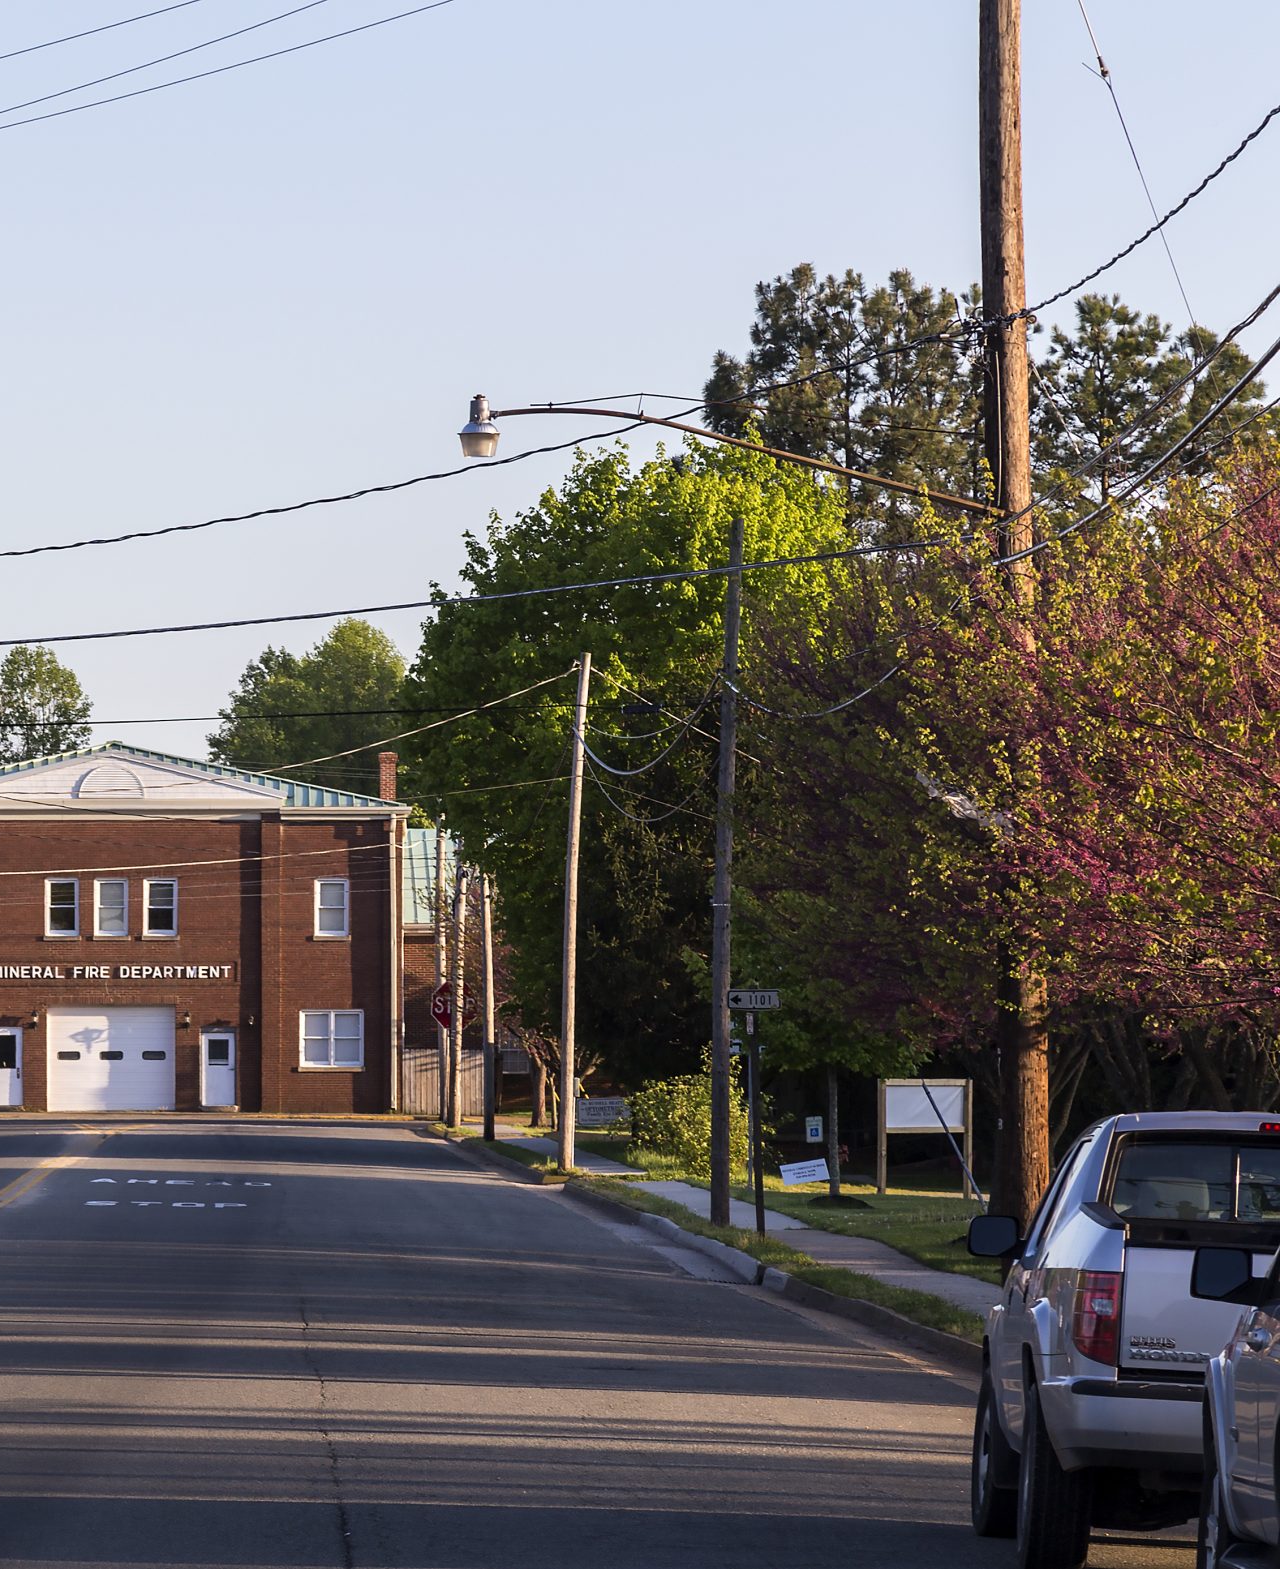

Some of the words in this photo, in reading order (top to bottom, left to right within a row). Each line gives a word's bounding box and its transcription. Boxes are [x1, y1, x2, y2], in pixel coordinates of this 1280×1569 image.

[73, 966, 110, 979] FIRE
[119, 965, 232, 979] DEPARTMENT
[434, 996, 476, 1014] STP
[749, 994, 772, 1006] 1101
[90, 1177, 272, 1187] AHEAD
[83, 1200, 248, 1208] STOP
